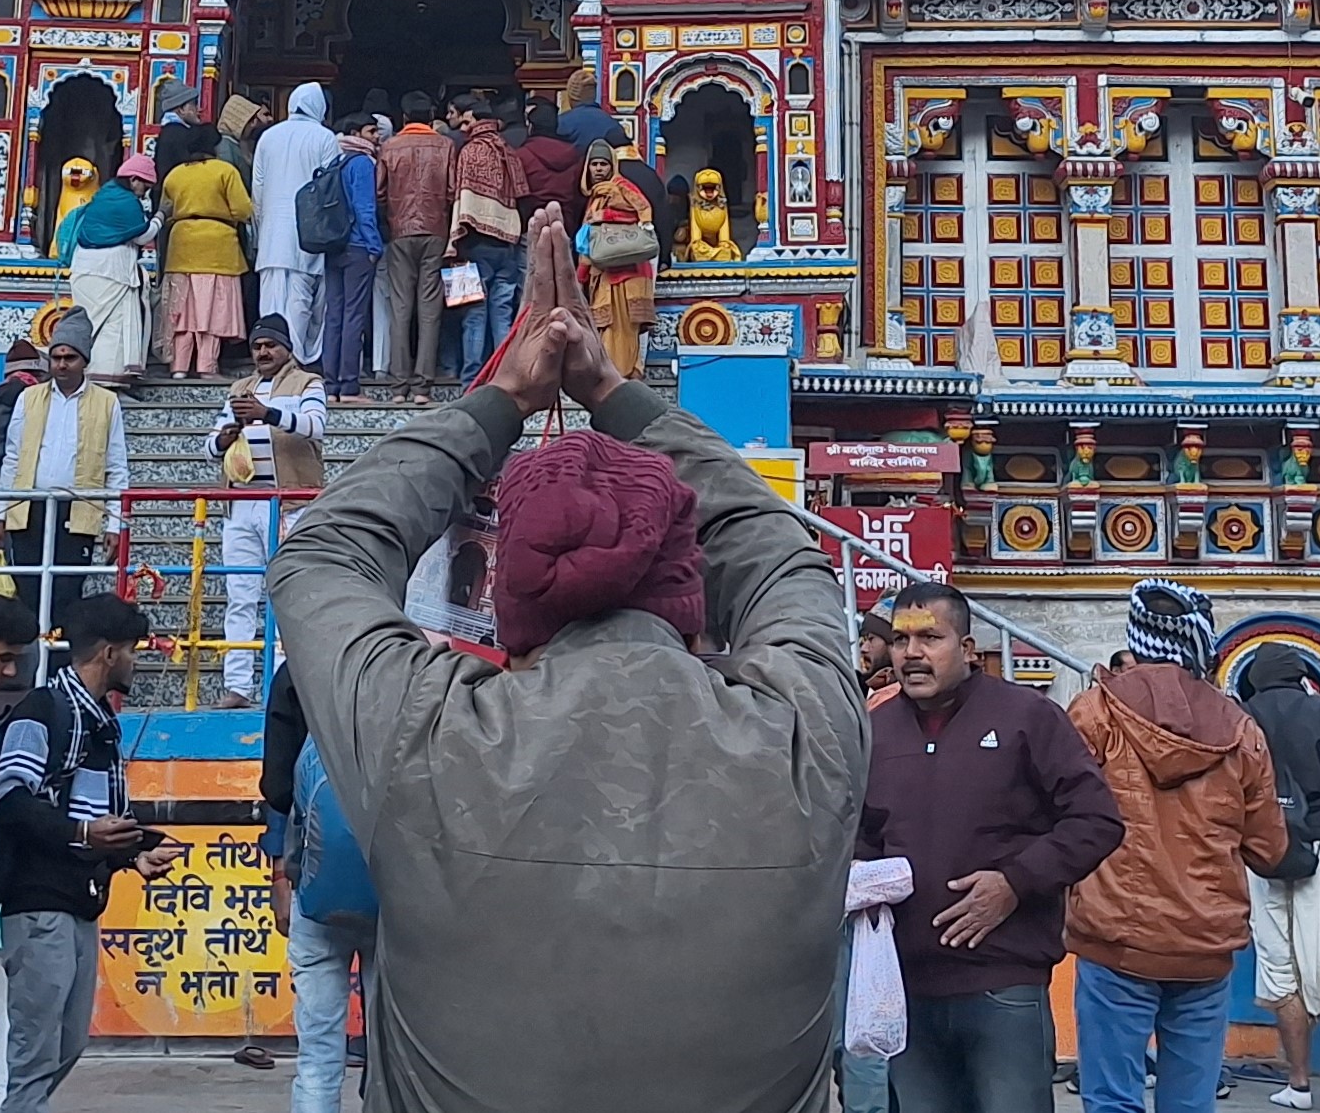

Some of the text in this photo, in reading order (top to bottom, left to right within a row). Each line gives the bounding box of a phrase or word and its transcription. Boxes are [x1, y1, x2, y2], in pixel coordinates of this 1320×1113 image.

[100, 920, 188, 967] सदृशं
[135, 971, 167, 997] न
[181, 961, 240, 1008] भूतो
[253, 971, 281, 998] न
